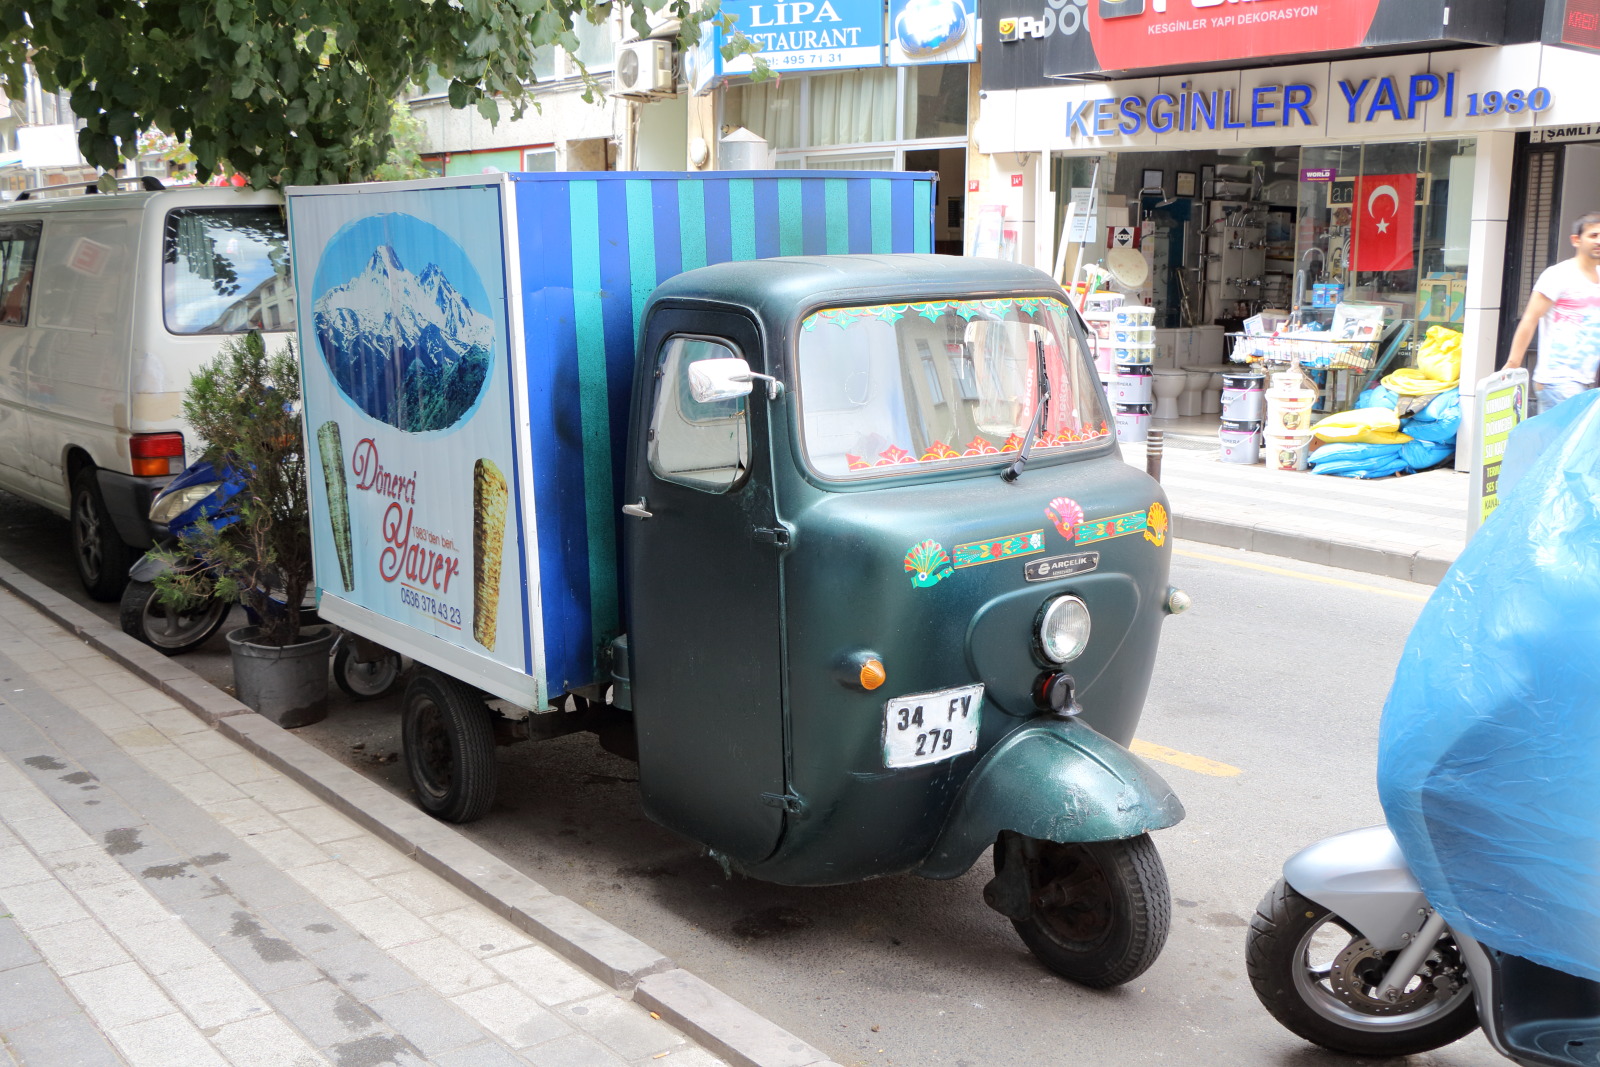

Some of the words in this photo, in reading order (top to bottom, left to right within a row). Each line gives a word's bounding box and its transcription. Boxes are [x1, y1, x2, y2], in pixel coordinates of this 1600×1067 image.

[749, 0, 842, 27] LİPA
[1148, 19, 1207, 35] KESGİNLER
[1211, 15, 1235, 28] YAPI
[1237, 5, 1319, 25] DEKORASYON
[726, 27, 862, 53] STAURANT
[762, 57, 779, 67] el:
[783, 55, 805, 65] 495
[809, 55, 823, 64] 71
[828, 53, 842, 63] 31
[1065, 82, 1314, 138] KESGİNLER
[1337, 72, 1457, 123] YAPI
[1466, 87, 1552, 117] 1980
[352, 438, 417, 505] Dönerci
[379, 502, 460, 594] Yaver
[401, 587, 420, 609] 0536
[421, 595, 437, 615] 378
[438, 602, 448, 620] 43
[449, 606, 462, 625] 23
[897, 706, 924, 731] 34
[948, 695, 972, 722] FV
[915, 728, 953, 757] 279
